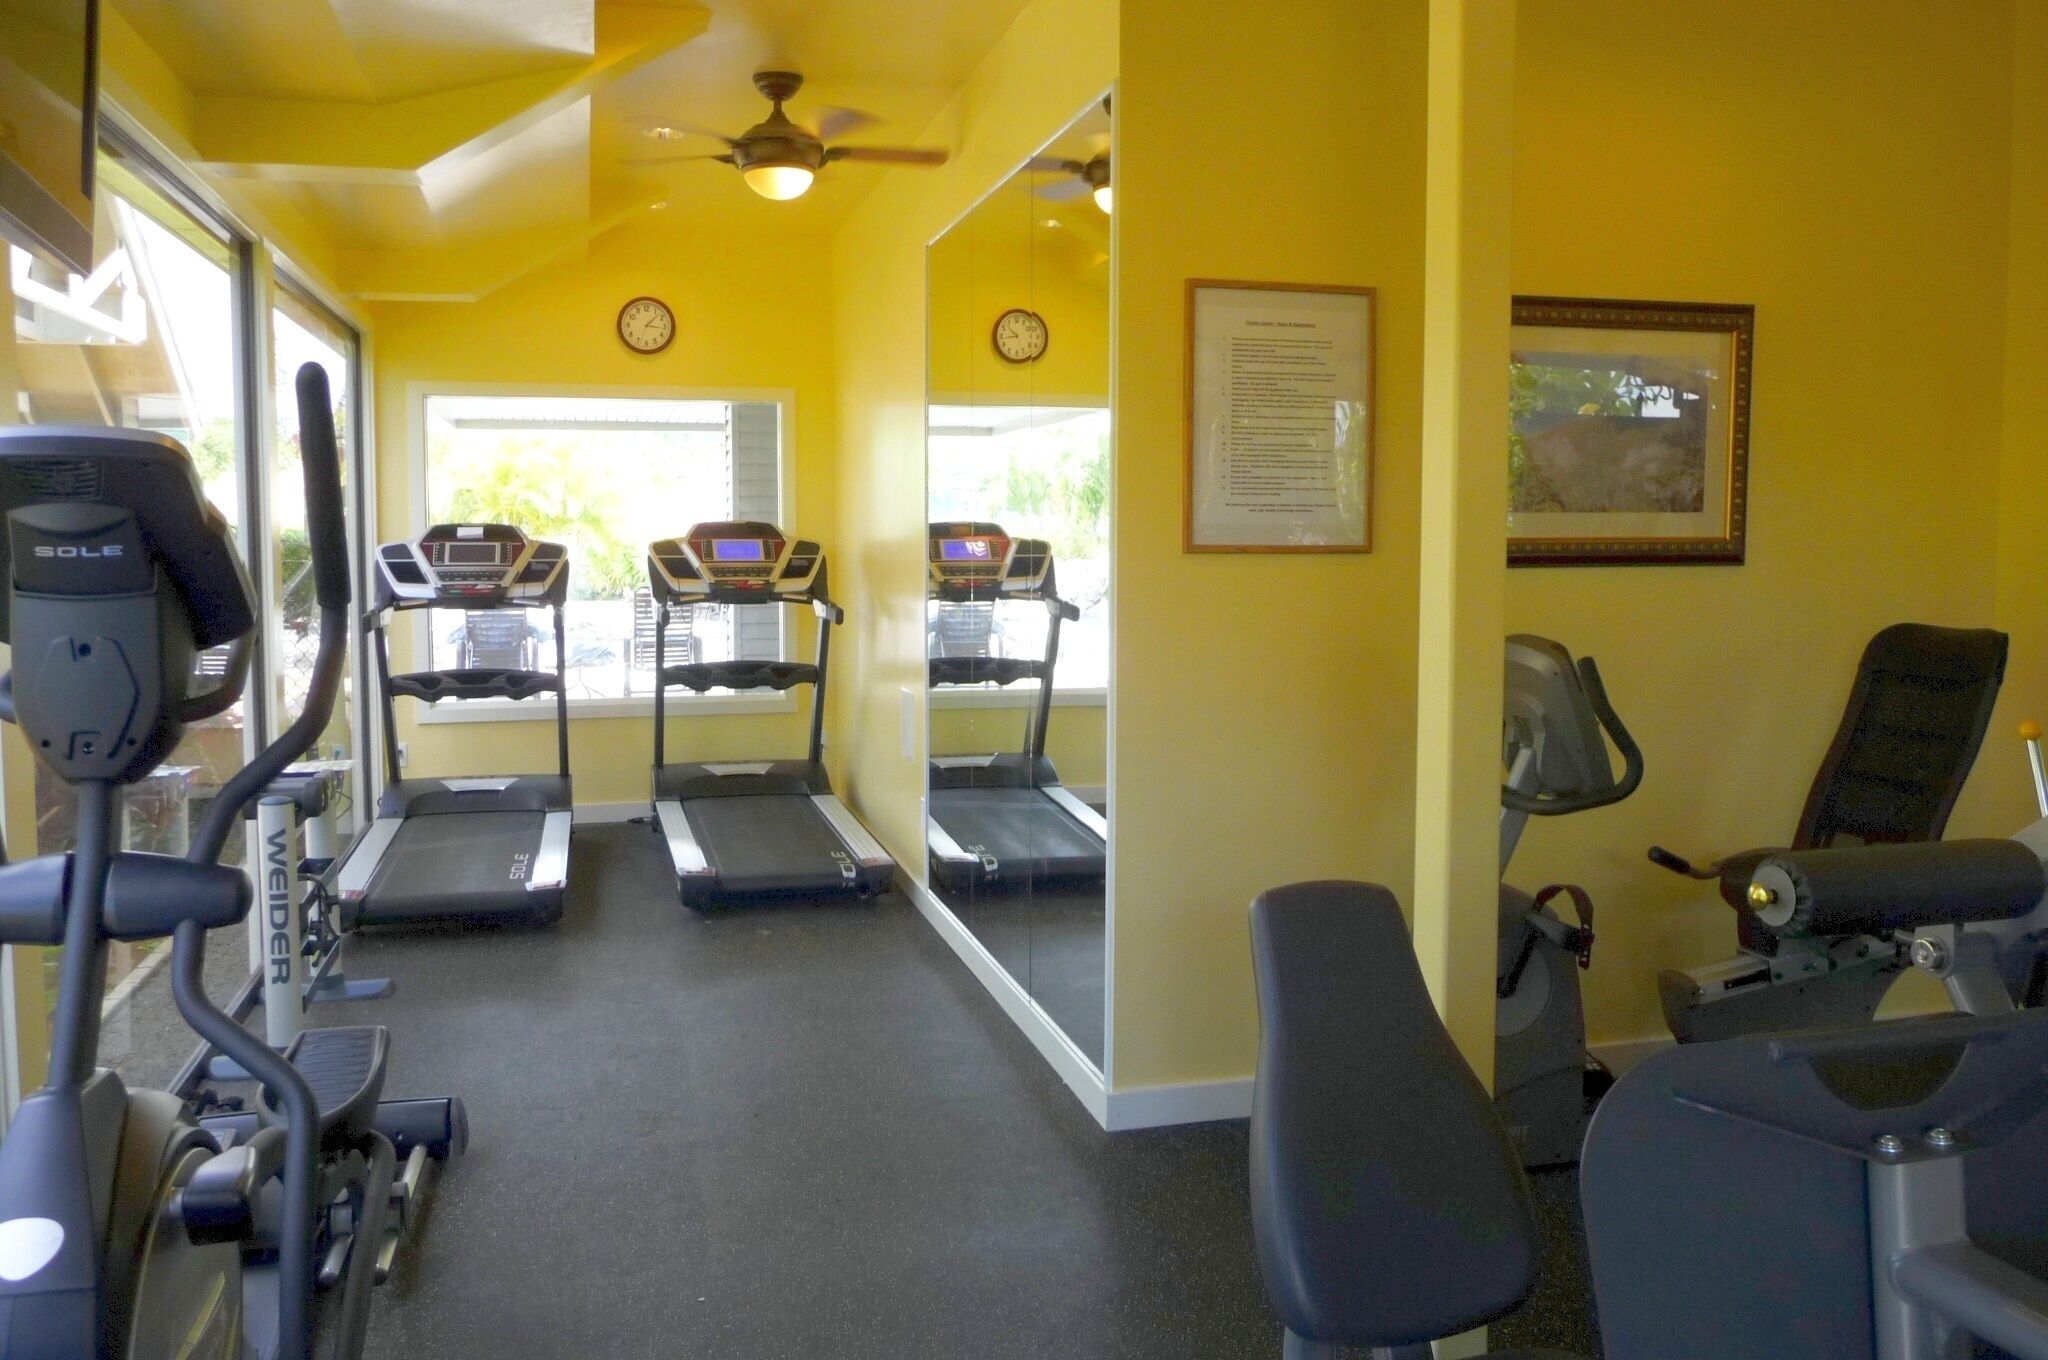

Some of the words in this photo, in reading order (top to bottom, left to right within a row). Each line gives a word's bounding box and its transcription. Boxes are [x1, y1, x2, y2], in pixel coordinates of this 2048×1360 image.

[34, 545, 124, 557] SOLE
[509, 853, 529, 879] SOLE
[267, 828, 291, 985] WEIDER
